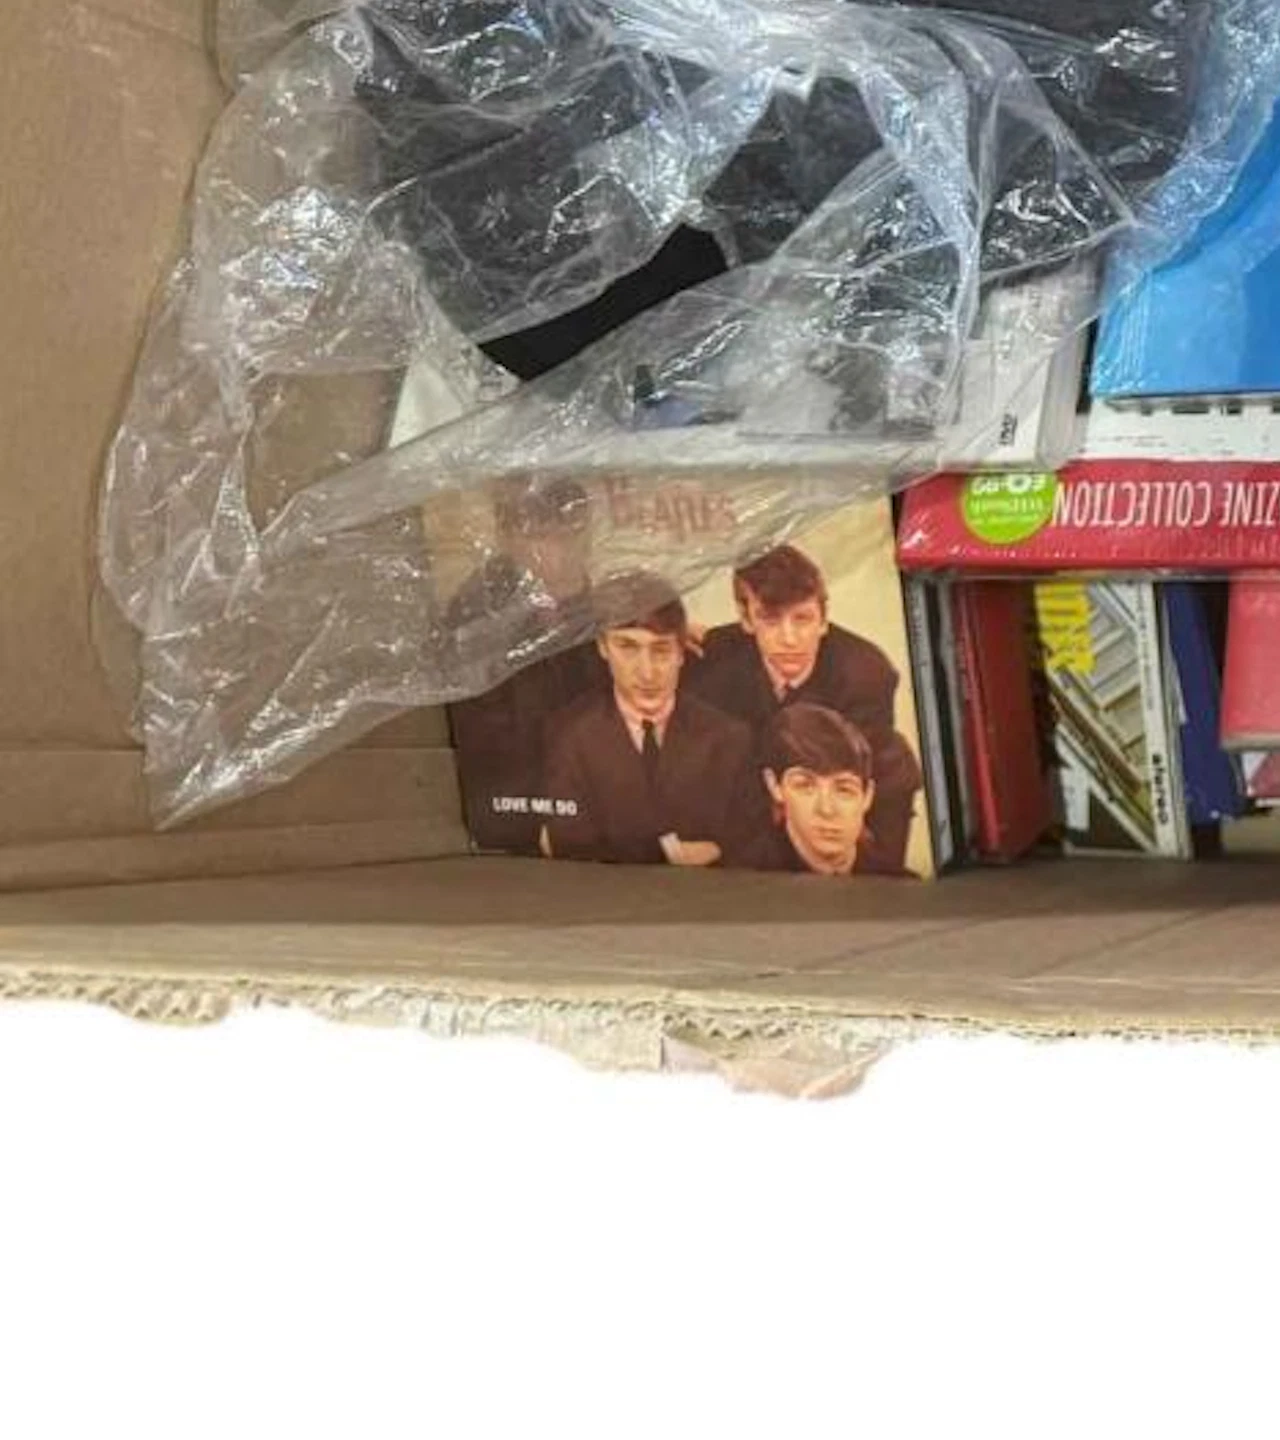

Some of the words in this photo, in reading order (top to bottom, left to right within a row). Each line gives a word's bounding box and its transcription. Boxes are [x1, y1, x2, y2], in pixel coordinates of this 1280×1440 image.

[1053, 478, 1212, 530] COLLECTION
[492, 795, 530, 815] LOVE
[530, 797, 554, 815] ME
[555, 798, 578, 817] DO
